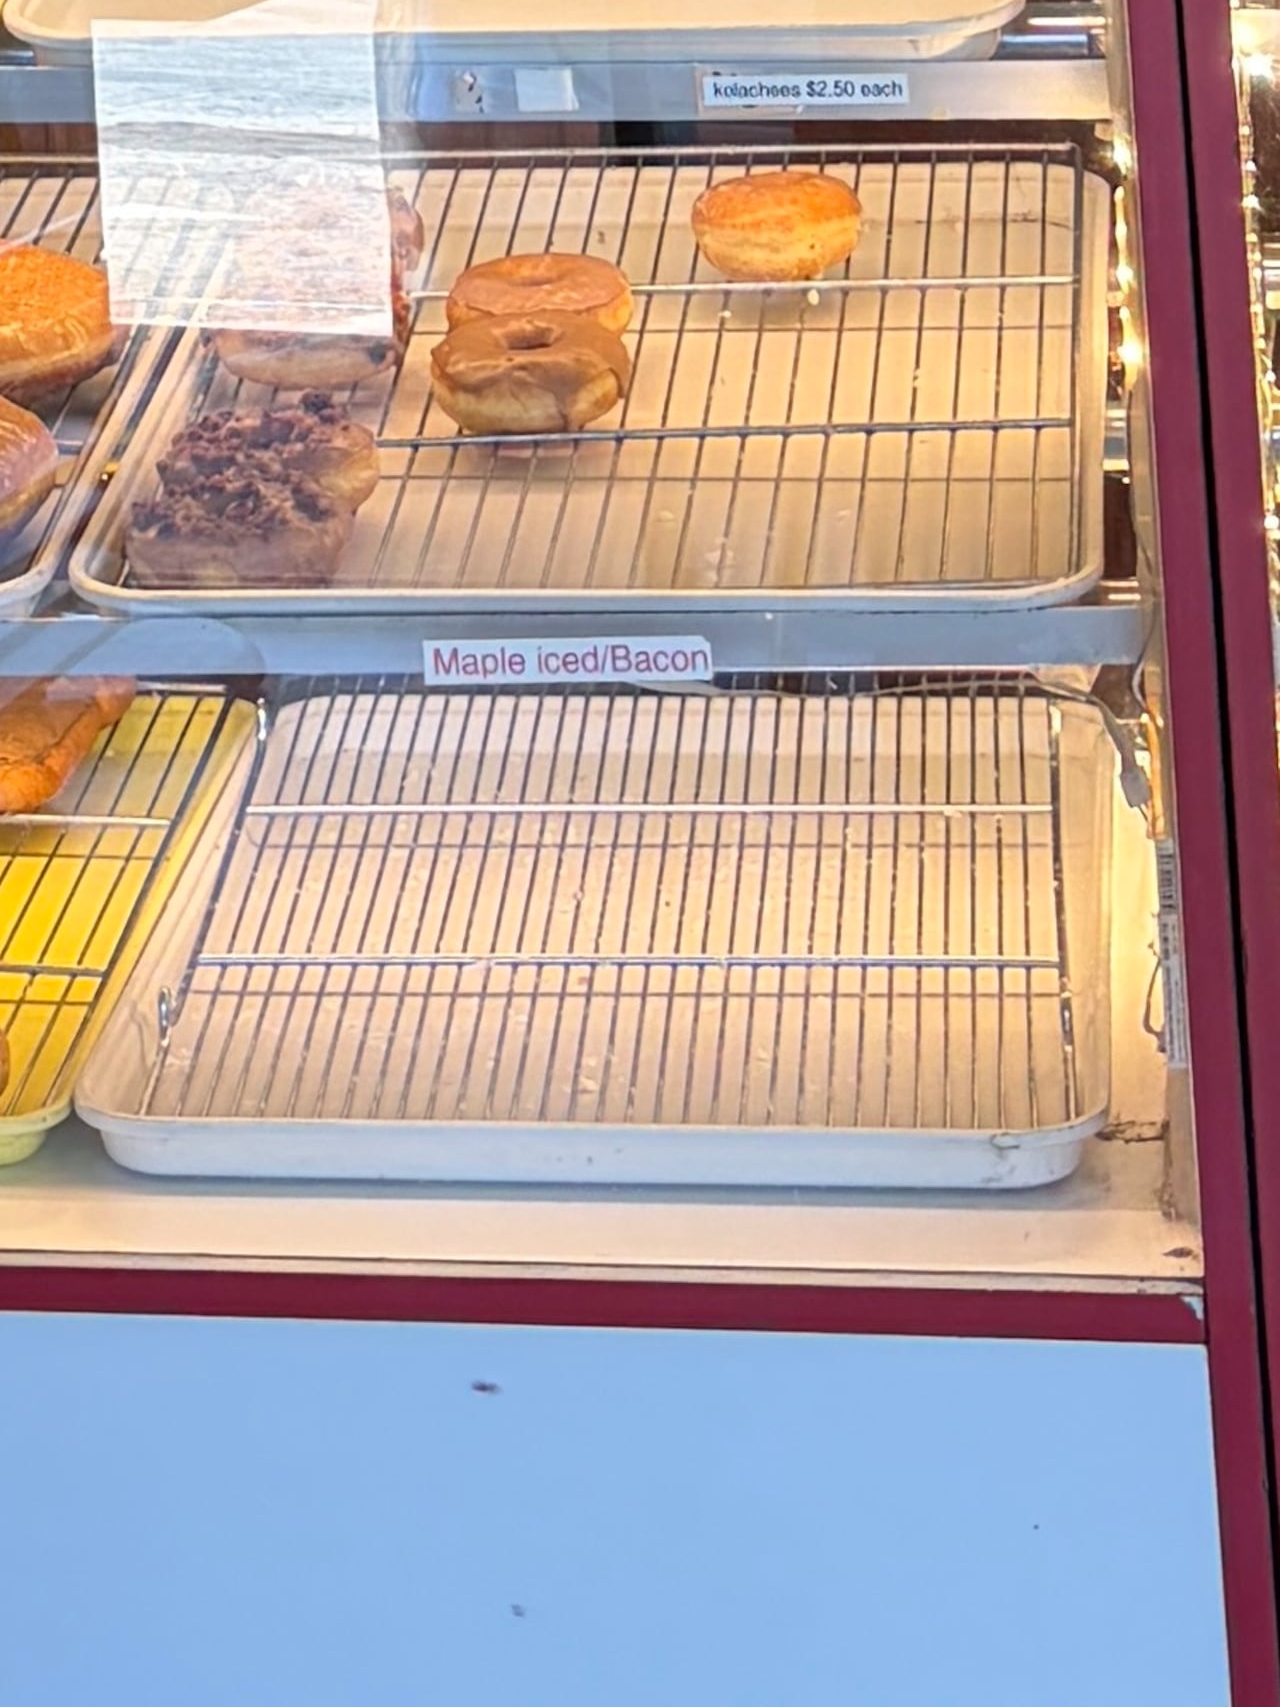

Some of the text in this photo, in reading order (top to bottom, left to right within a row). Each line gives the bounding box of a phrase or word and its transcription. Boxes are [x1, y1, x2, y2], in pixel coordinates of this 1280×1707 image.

[806, 80, 855, 97] $2.50
[861, 81, 902, 97] each
[434, 644, 708, 678] Maple iced/Bacon
